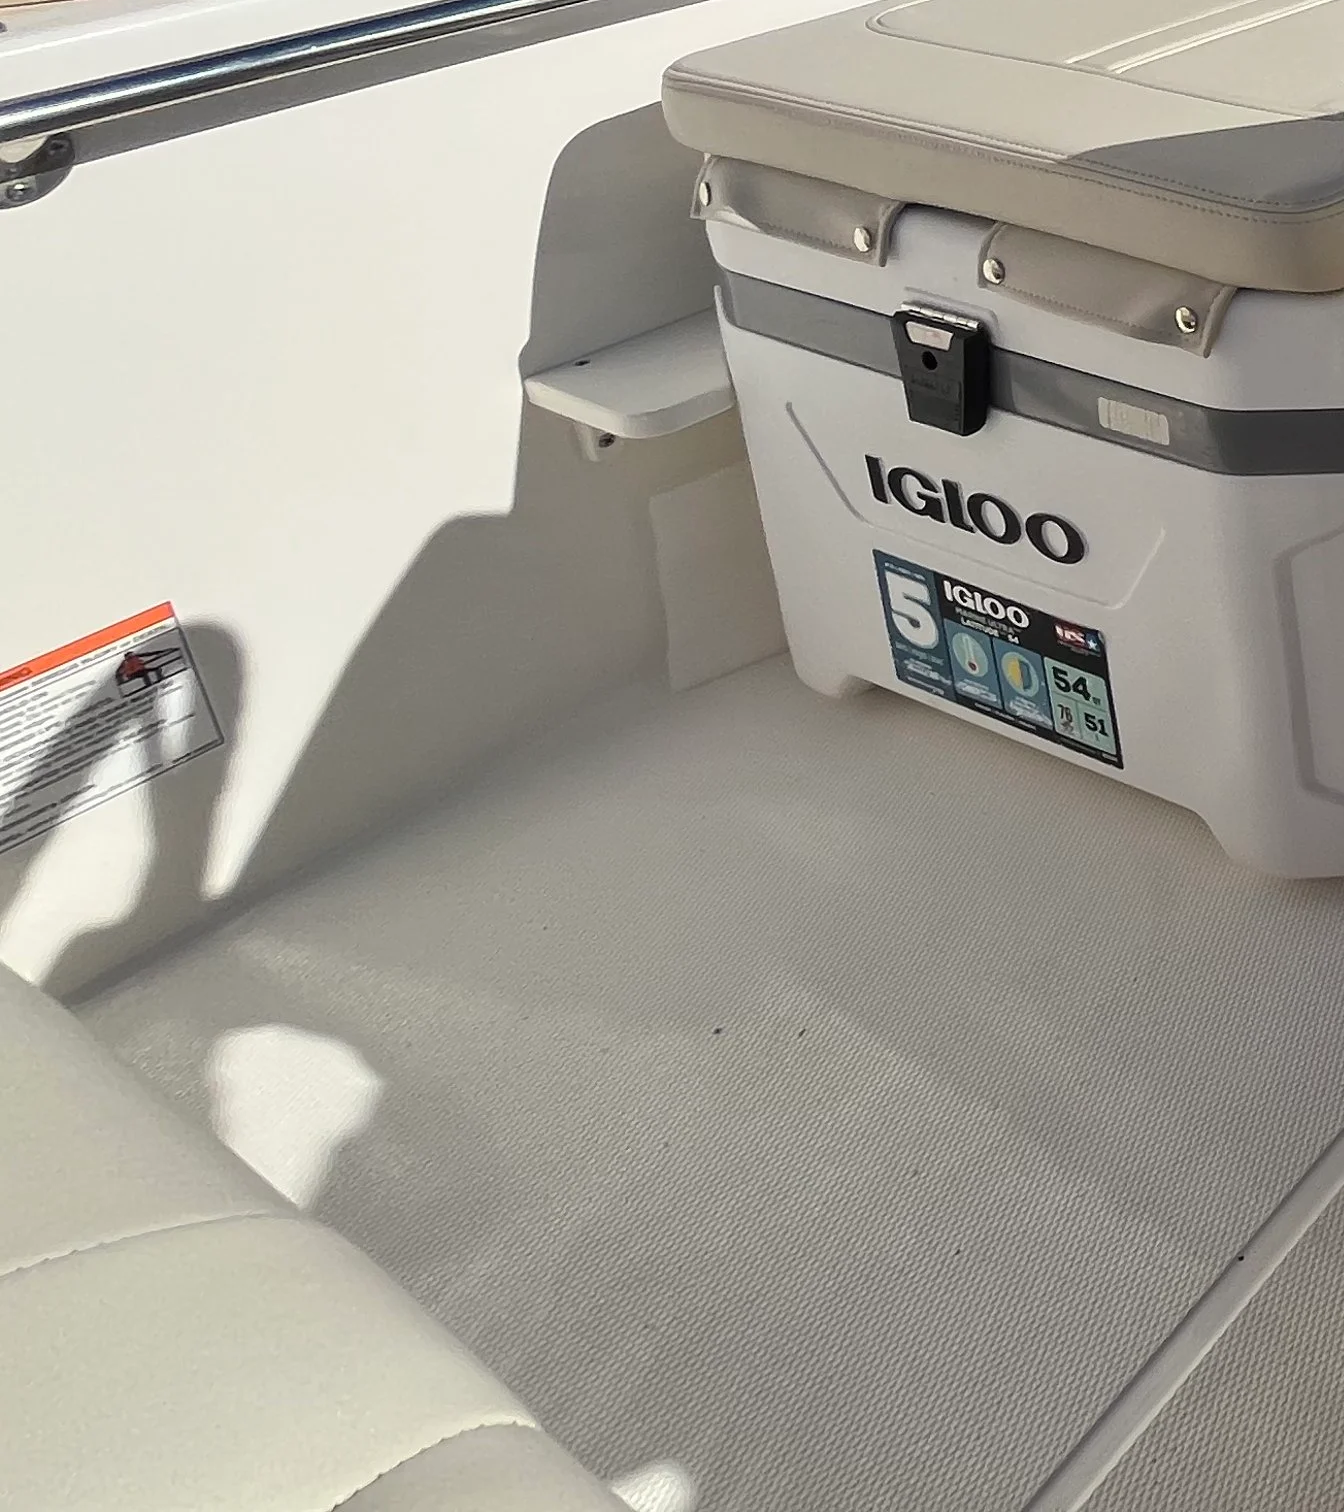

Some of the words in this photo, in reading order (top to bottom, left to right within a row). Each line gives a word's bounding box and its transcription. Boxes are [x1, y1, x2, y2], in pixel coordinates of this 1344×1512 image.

[865, 454, 1085, 565] IGLOO
[884, 569, 938, 650] 5
[943, 580, 1030, 629] IGLOO
[1052, 666, 1091, 702] 54
[1083, 711, 1108, 737] 51
